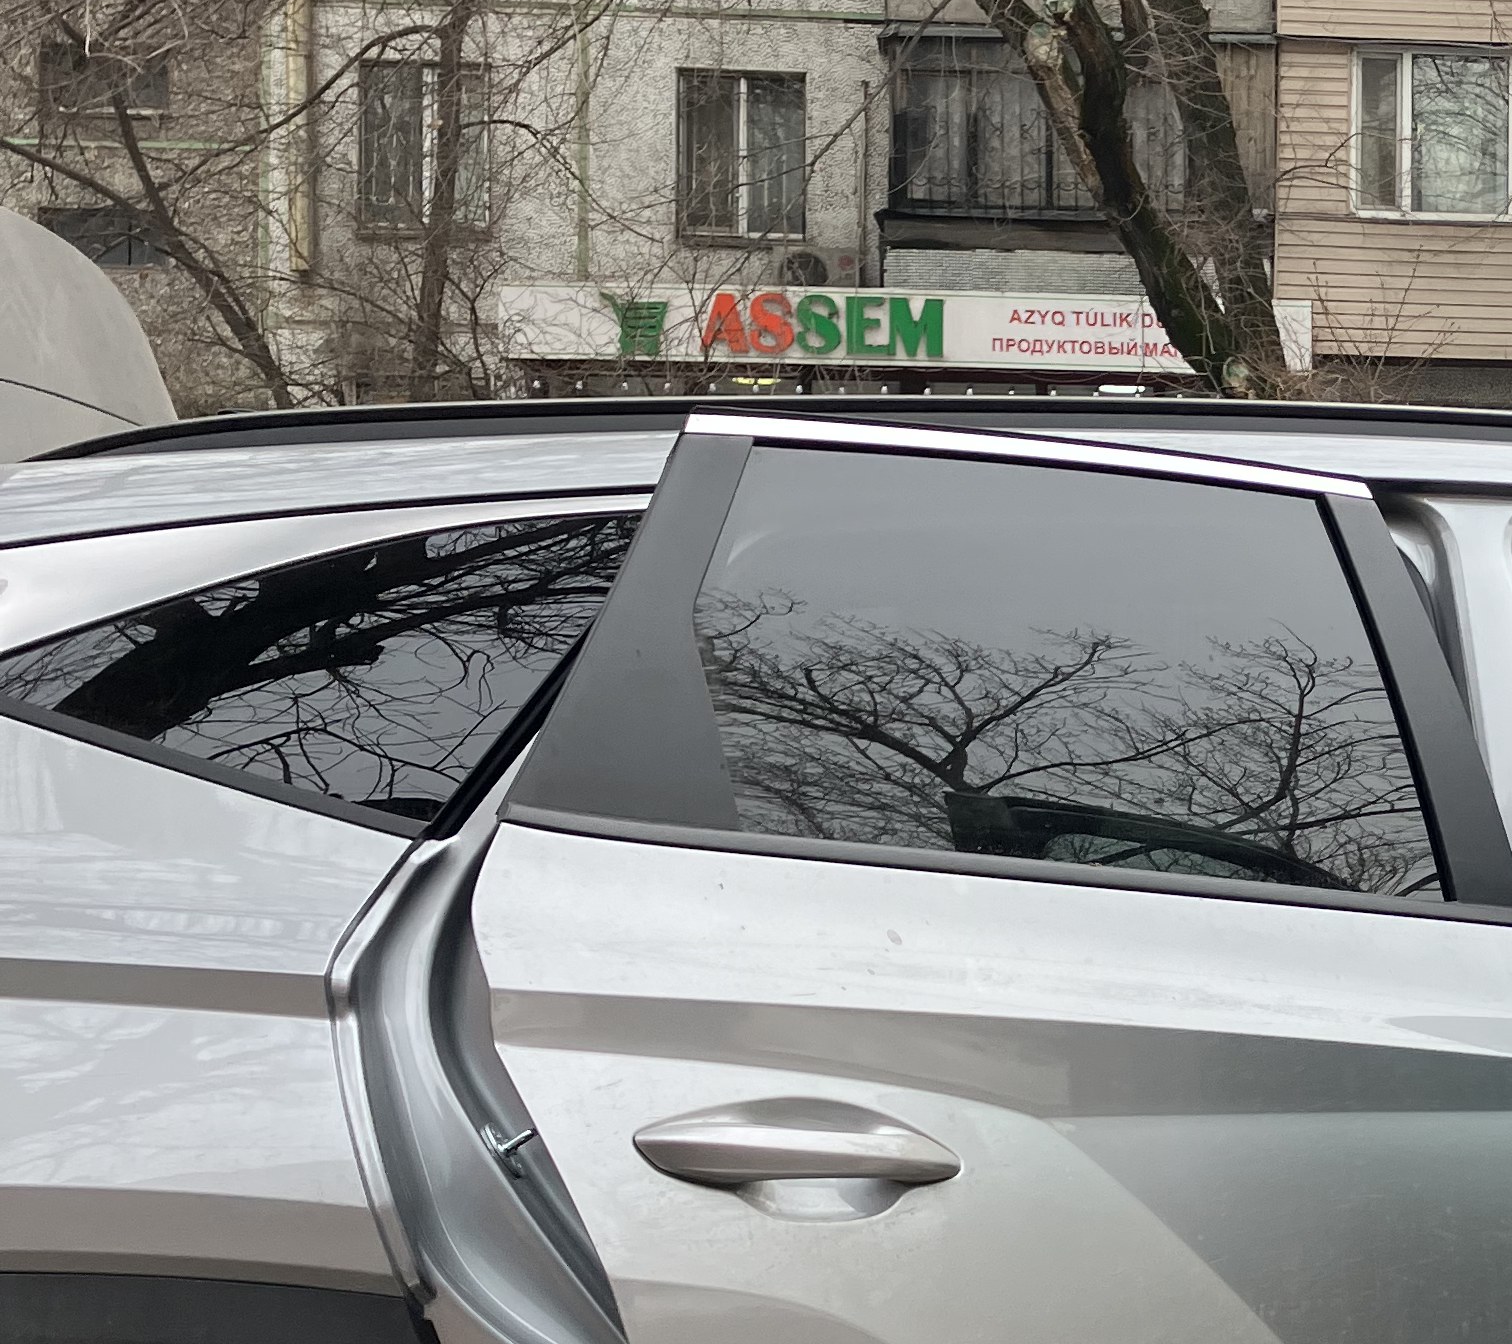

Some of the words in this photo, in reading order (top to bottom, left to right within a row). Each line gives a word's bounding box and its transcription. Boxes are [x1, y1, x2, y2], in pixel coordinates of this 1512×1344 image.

[700, 293, 944, 358] ASSEM
[1009, 309, 1065, 327] AZYQ
[992, 338, 1138, 356] ПРОДУКТОВЫЙ
